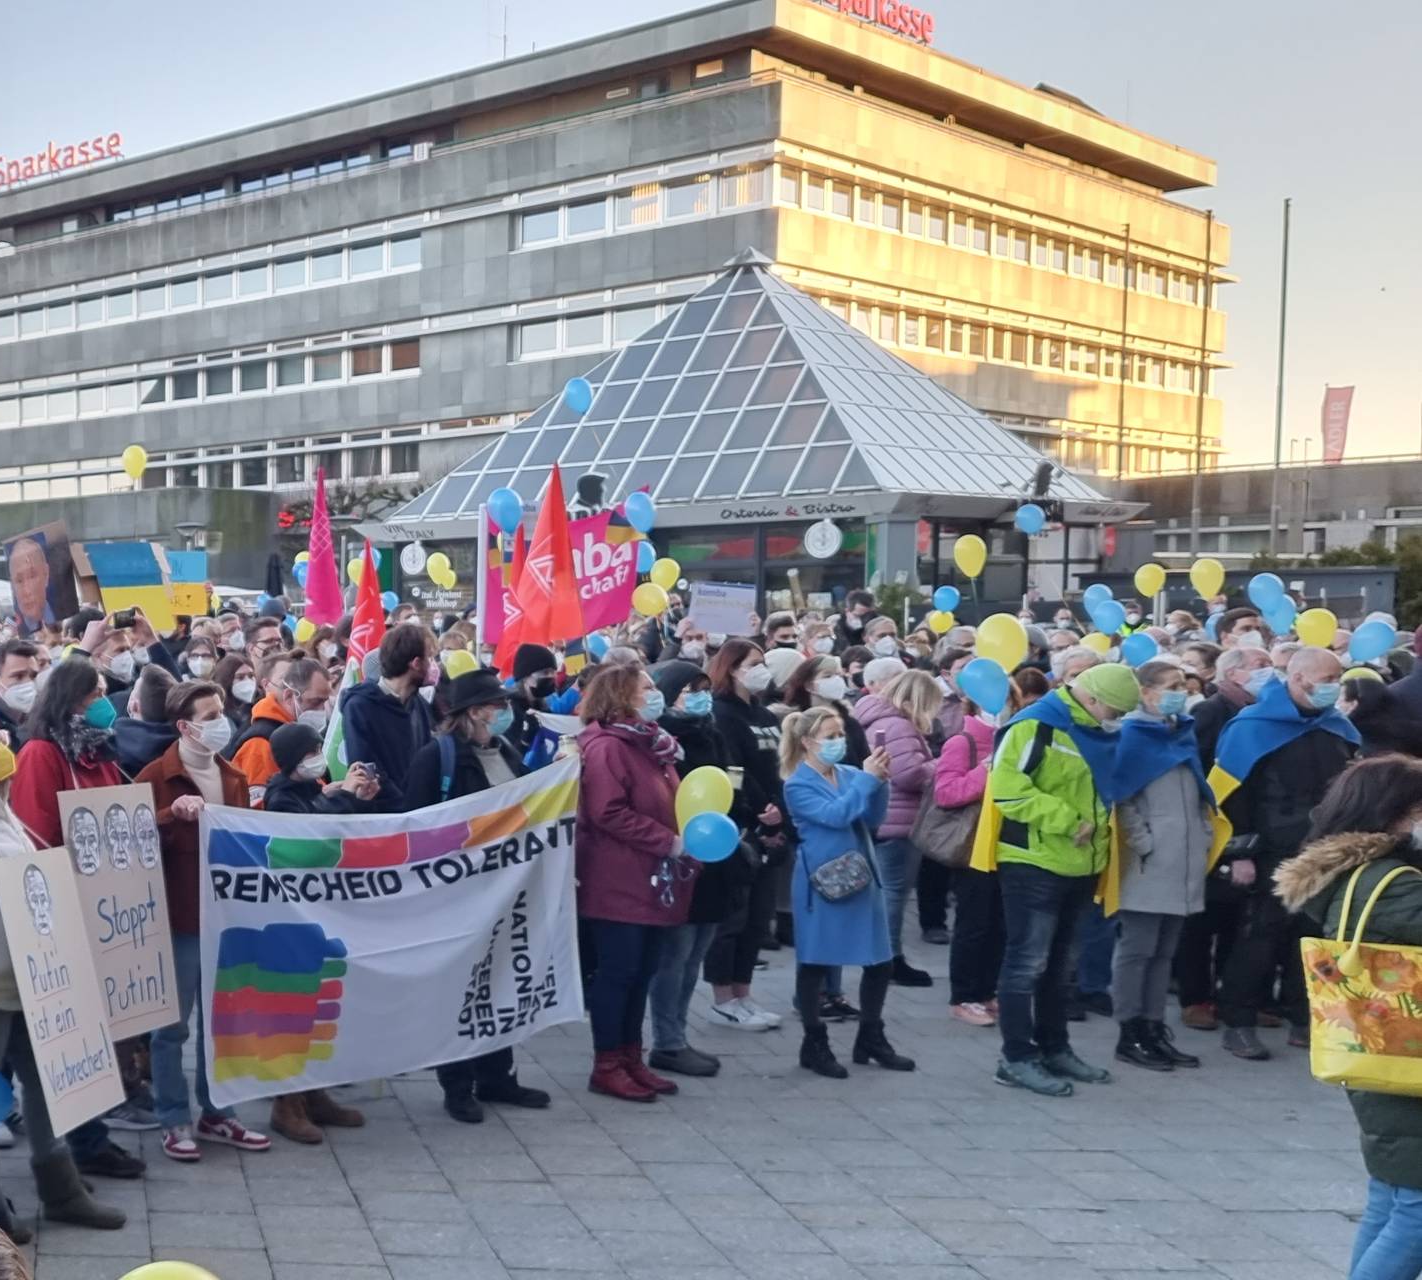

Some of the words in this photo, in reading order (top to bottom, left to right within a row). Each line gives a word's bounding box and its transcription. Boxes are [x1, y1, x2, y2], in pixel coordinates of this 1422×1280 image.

[721, 506, 778, 519] Osteria
[785, 504, 799, 517] &
[802, 503, 856, 515] Bistro
[210, 868, 402, 903] REMSCHEID
[97, 880, 156, 949] Stoppt
[27, 950, 71, 995] Putin
[511, 889, 533, 1028] NATIONEN
[104, 951, 166, 1018] Putin!
[31, 1006, 50, 1041] ist
[54, 1001, 76, 1034] ein
[497, 1006, 515, 1034] IN
[43, 1022, 113, 1096] Verbrecher!
